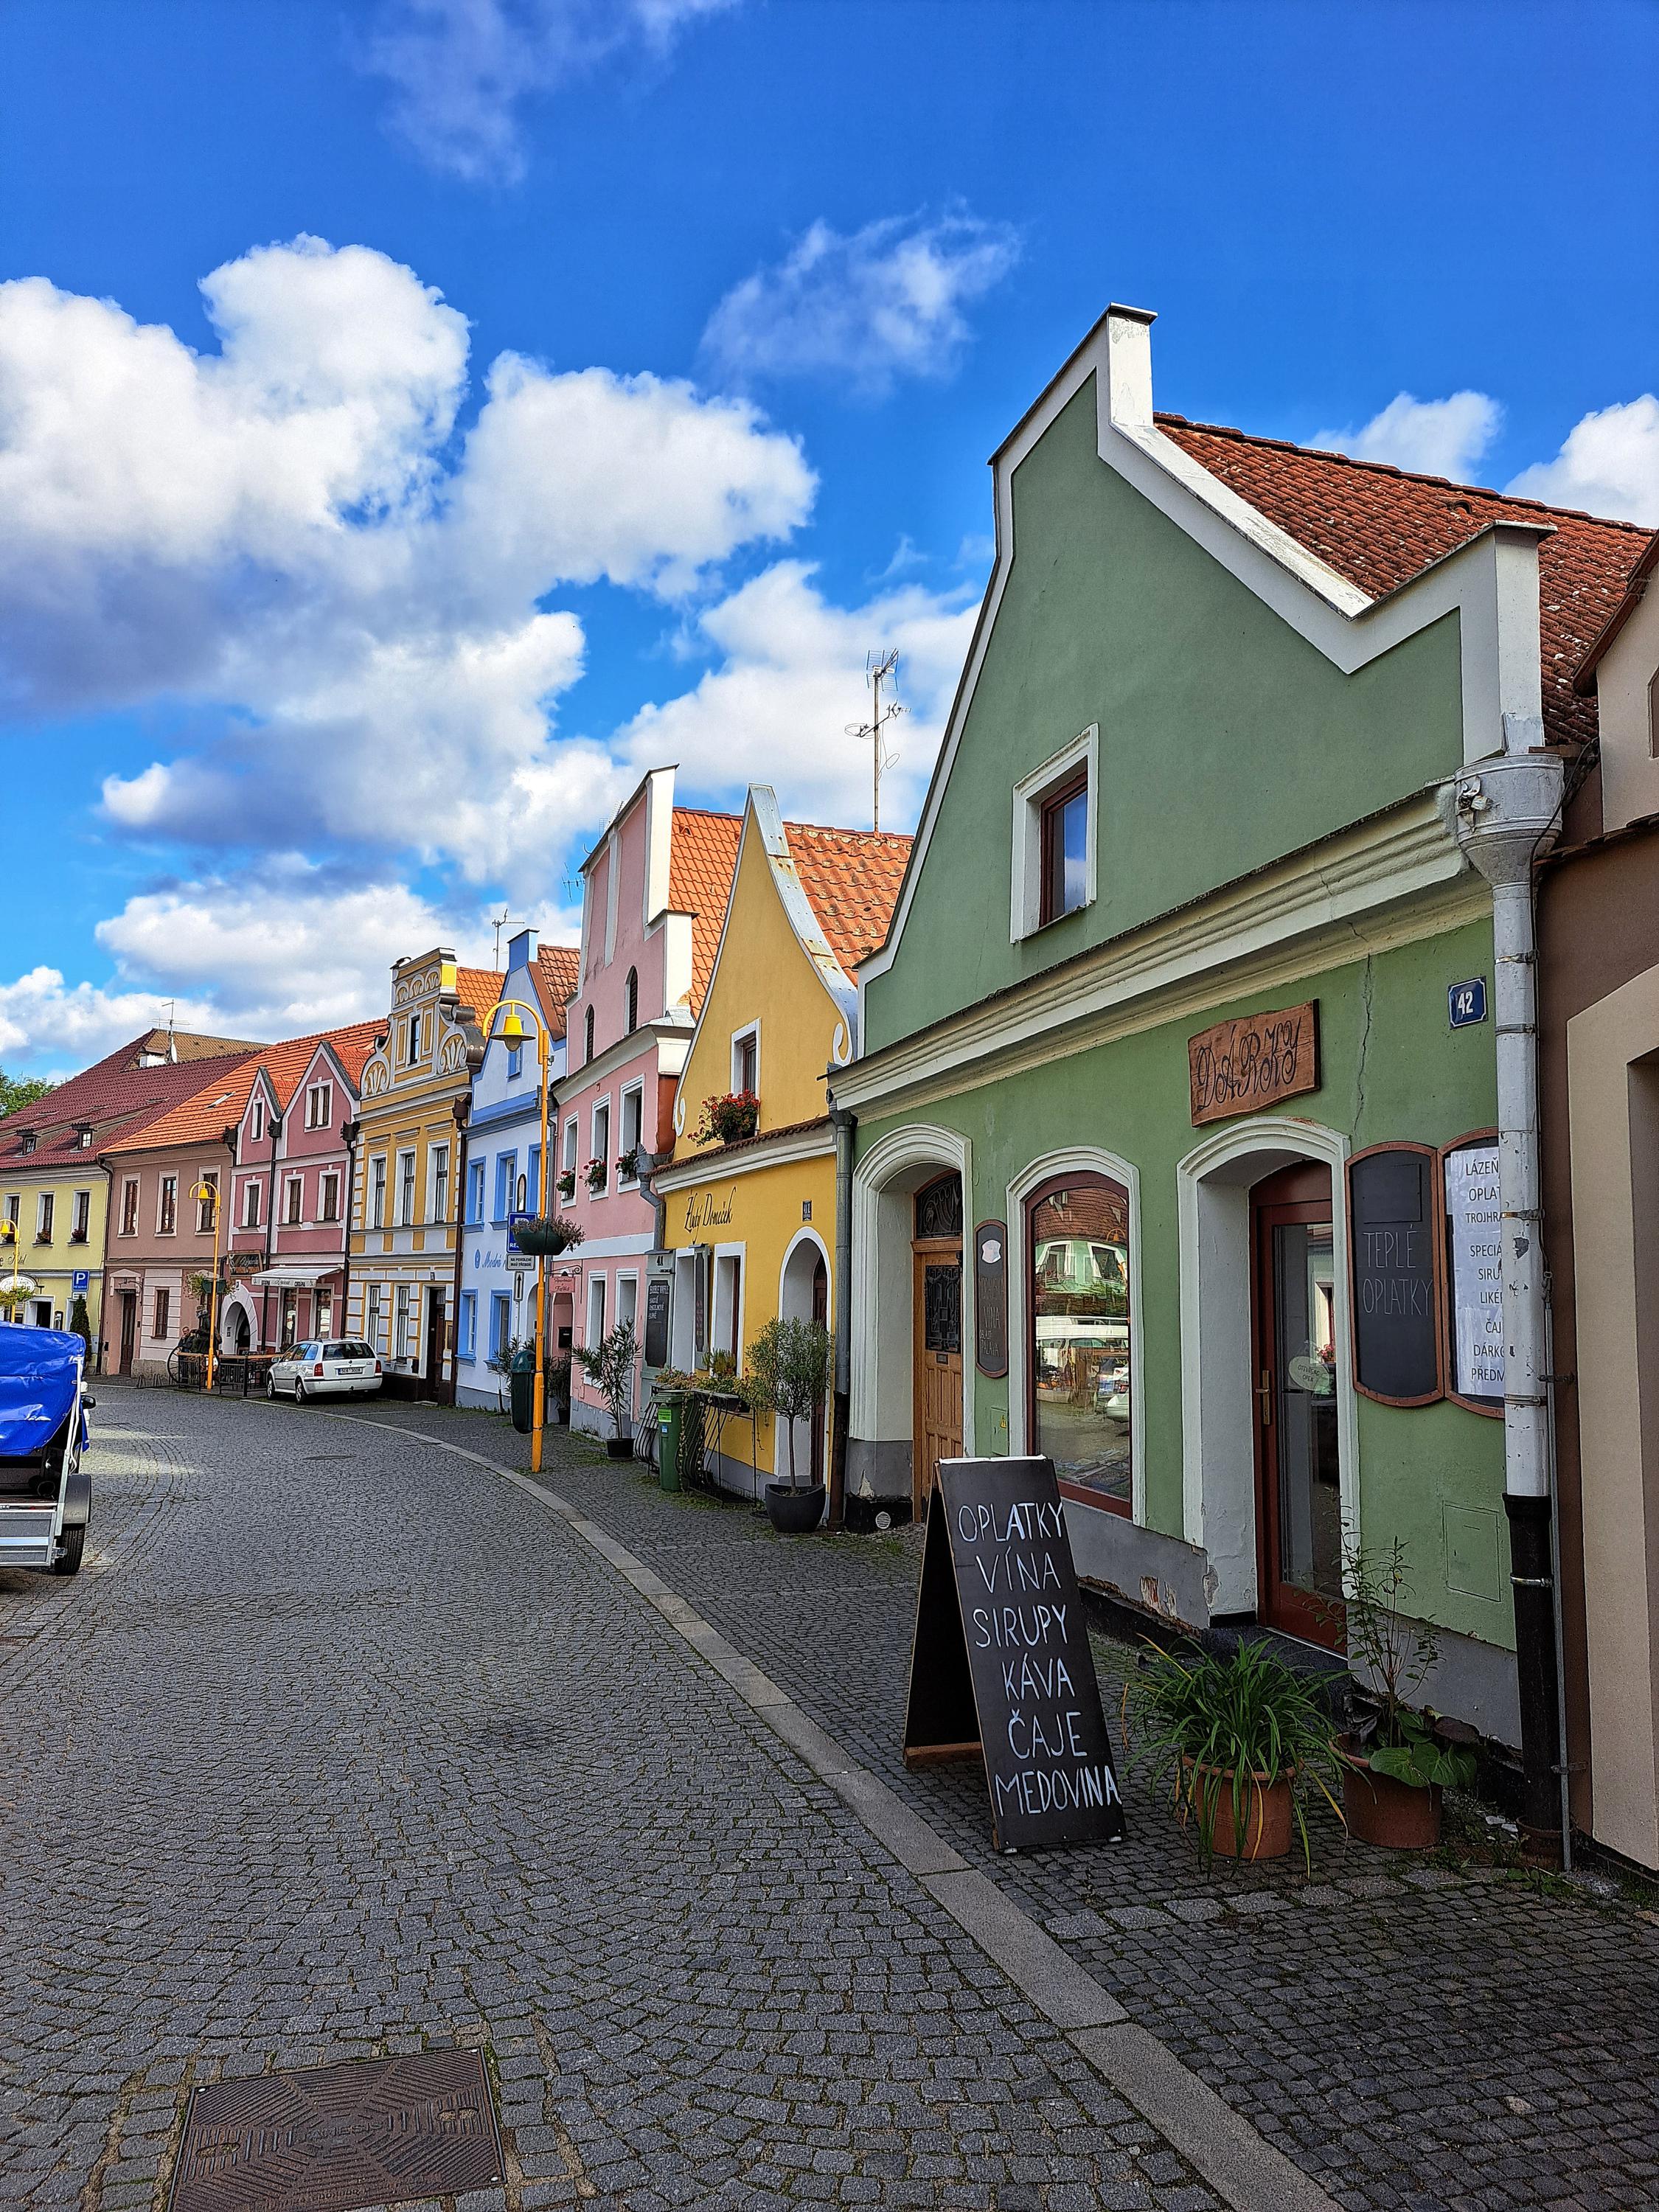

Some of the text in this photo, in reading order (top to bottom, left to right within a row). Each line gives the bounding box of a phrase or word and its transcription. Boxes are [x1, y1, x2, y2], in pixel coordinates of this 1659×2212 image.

[1458, 991, 1473, 1015] 42
[1466, 1157, 1499, 1176] LÁZEŇ
[1465, 1211, 1502, 1223] TROJHR
[1363, 1223, 1417, 1268] TEPLÉ
[1470, 1241, 1502, 1257] SPECIÁ
[656, 1256, 664, 1266] 41
[76, 1273, 86, 1284] P
[1478, 1267, 1502, 1280] SIRU
[1363, 1279, 1433, 1316] OPLATKY
[1485, 1318, 1501, 1333] ČAJ
[1471, 1366, 1504, 1382] PŘEDM
[959, 1503, 1062, 1542] OPLATKY
[976, 1545, 1061, 1593] VÍNA
[973, 1604, 1068, 1648] SIRUPY
[1002, 1652, 1075, 1701] KÁVA
[1008, 1708, 1088, 1759] ČAJE
[995, 1765, 1122, 1817] MEDOVINA
